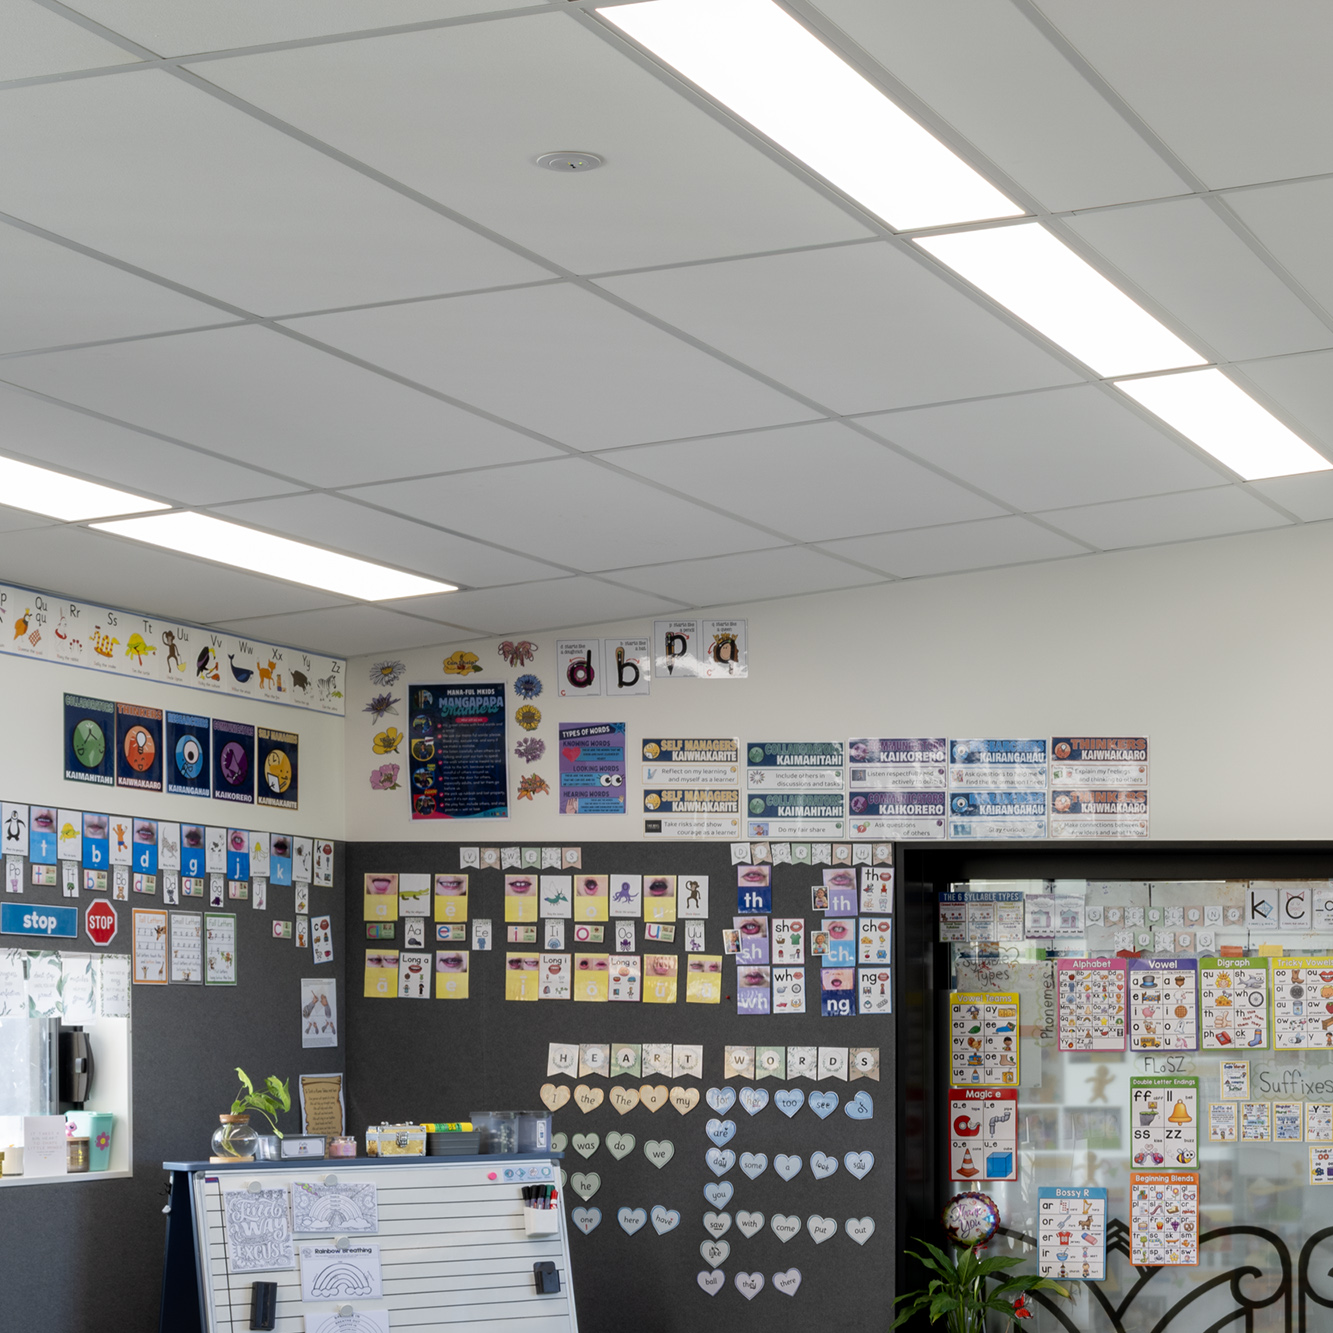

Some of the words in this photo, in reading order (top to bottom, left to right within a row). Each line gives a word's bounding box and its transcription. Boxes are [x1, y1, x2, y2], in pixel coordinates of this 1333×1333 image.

[35, 597, 48, 612] Qu
[69, 605, 80, 618] Rr
[107, 612, 118, 627] Ss
[176, 627, 189, 641] Uu
[239, 641, 253, 655] Ww
[332, 661, 341, 674] Zz
[439, 696, 504, 708] MANGAPAPA
[117, 704, 163, 721] THINKERS
[441, 704, 499, 717] Manners
[562, 729, 580, 738] TYPES
[589, 726, 610, 734] WORDS
[660, 740, 684, 750] SELF
[685, 739, 736, 750] MANAGERS
[1071, 739, 1146, 749] THINKERS
[672, 751, 737, 761] KAIWHAKARITE
[776, 755, 842, 766] KAIMAHITAHI
[980, 752, 1044, 763] KAIRANGAHAU
[1082, 750, 1146, 760] KAIWHAKAARO
[66, 770, 113, 785] KAIMAHITAHI
[702, 768, 727, 776] learning
[118, 776, 161, 790] KAIWHAKAARO
[169, 784, 209, 796] KAIRANGAHAU
[215, 790, 252, 803] KAIKORERO
[868, 793, 943, 804] COMMUNICATORS
[258, 796, 297, 809] KAIWHAKARITE
[879, 804, 943, 815] KAIKORERO
[865, 869, 879, 881] th
[943, 893, 957, 901] THE
[964, 893, 997, 901] SYLLABLE
[998, 893, 1019, 901] TYPES
[23, 912, 57, 935] stop
[89, 915, 113, 930] STOP
[775, 920, 790, 933] sh
[862, 920, 877, 933] ch
[403, 955, 421, 965] Long
[543, 957, 563, 965] Long
[611, 958, 630, 967] Long
[1073, 960, 1111, 971] Alphabet
[1148, 960, 1177, 968] Vowel
[1217, 959, 1250, 968] Digraph
[1278, 959, 1303, 967] Tricky
[775, 969, 793, 981] wh
[862, 973, 877, 985] ng
[976, 969, 1010, 987] Types
[957, 995, 983, 1003] Vowel
[985, 994, 1012, 1003] Teams
[1041, 972, 1055, 1039] Phonemes
[1260, 1069, 1333, 1095] Suffixes
[581, 1094, 595, 1105] the
[615, 1094, 632, 1106] The
[965, 1090, 993, 1099] Magic
[676, 1098, 691, 1108] my
[782, 1098, 797, 1107] too
[816, 1100, 830, 1109] see
[577, 1141, 595, 1150] was
[614, 1140, 625, 1151] do
[653, 1150, 666, 1158] we
[816, 1160, 829, 1172] look
[1136, 1175, 1170, 1184] Beginning
[580, 1181, 591, 1191] he
[712, 1191, 726, 1201] you
[1056, 1189, 1081, 1198] Bossy
[1083, 1189, 1090, 1197] R
[951, 1203, 983, 1223] Thank
[624, 1215, 639, 1224] here
[655, 1215, 672, 1226] have
[710, 1221, 724, 1229] saw
[742, 1219, 758, 1229] with
[776, 1224, 795, 1232] come
[814, 1226, 827, 1235] put
[855, 1226, 866, 1234] out
[960, 1219, 981, 1239] You
[705, 1277, 717, 1285] ball
[780, 1278, 796, 1287] there
